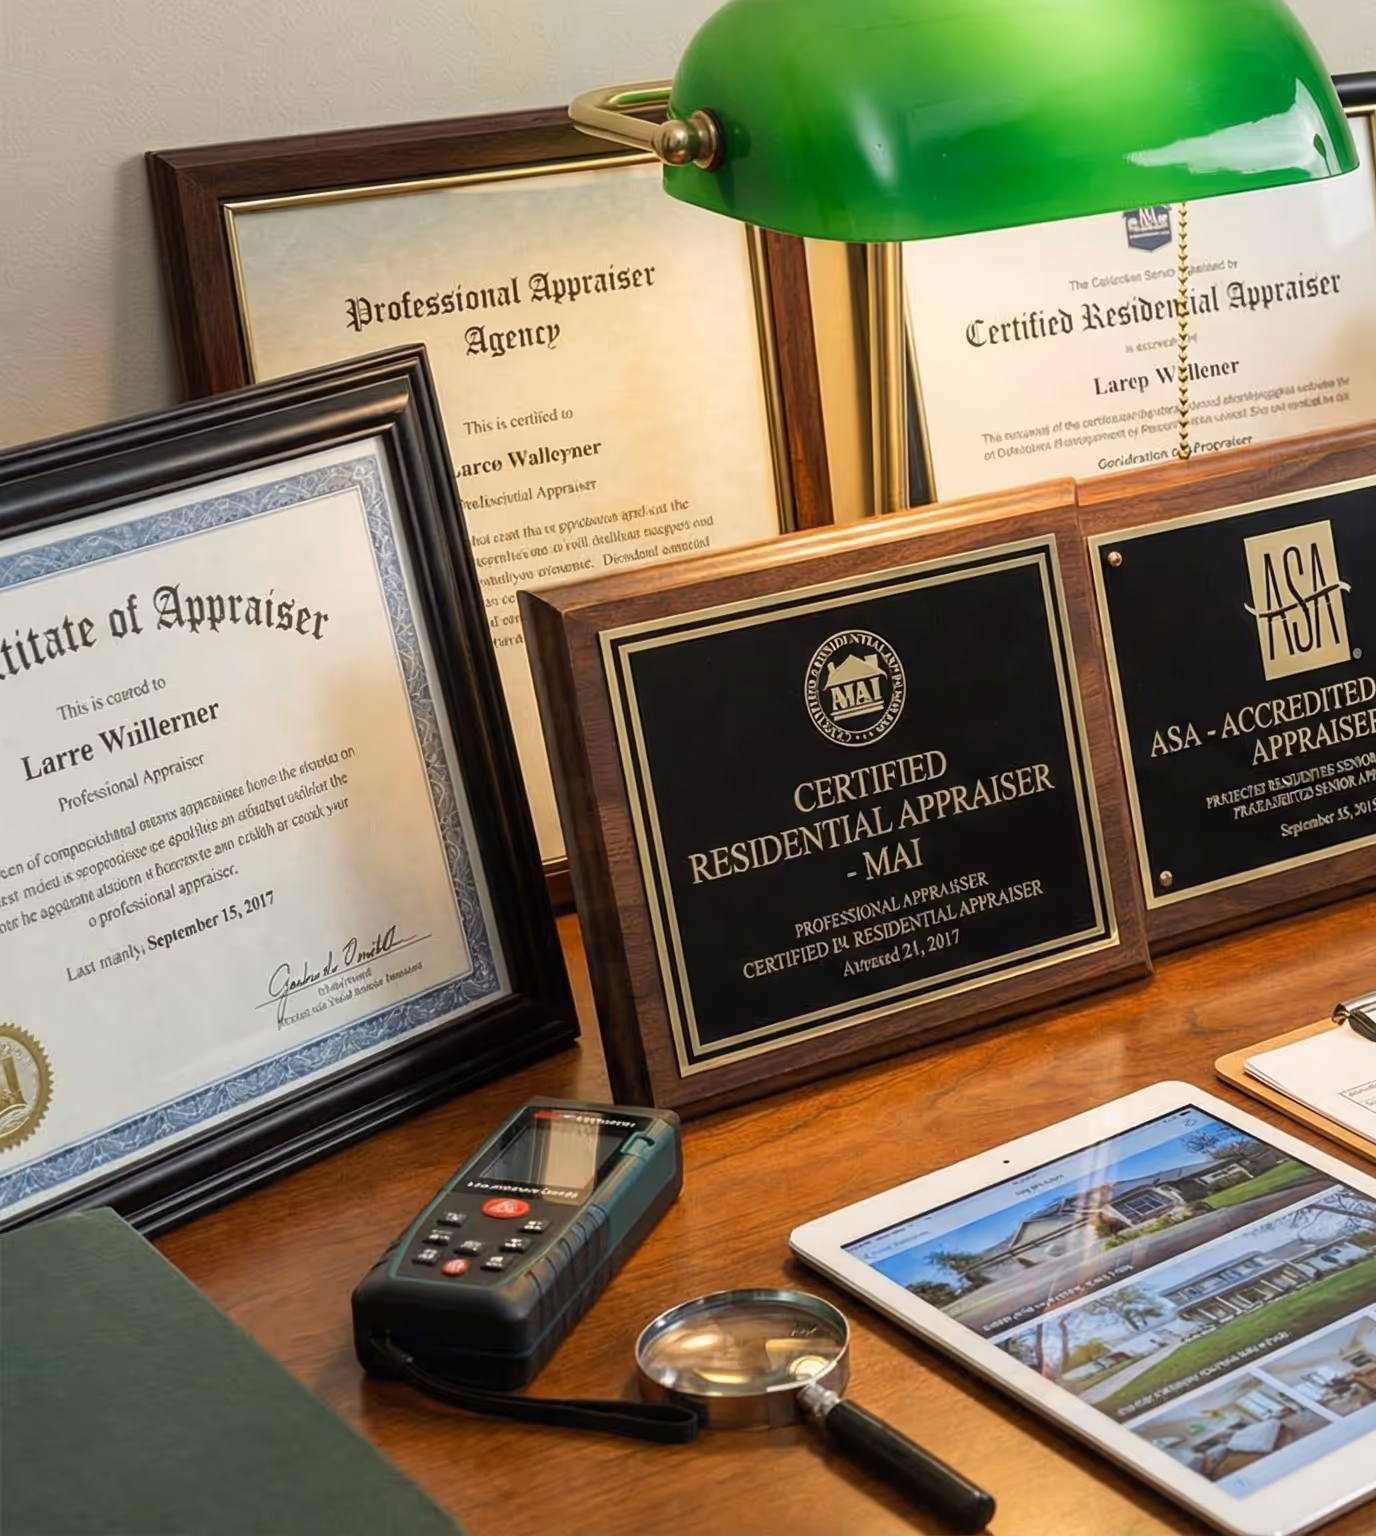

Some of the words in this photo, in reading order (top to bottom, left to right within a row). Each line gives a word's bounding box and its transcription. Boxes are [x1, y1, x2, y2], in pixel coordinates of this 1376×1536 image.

[345, 276, 521, 333] Professional
[528, 263, 657, 304] Appraiser
[965, 307, 1073, 348] Certified
[1226, 272, 1343, 311] Appraiser
[464, 321, 561, 357] Agency
[463, 418, 494, 436] This
[496, 416, 508, 430] is
[561, 408, 574, 419] to
[109, 593, 144, 638] of
[153, 583, 330, 640] Appraiser
[1261, 542, 1341, 661] ASA
[56, 699, 90, 721] This
[91, 696, 104, 712] is
[151, 677, 166, 692] to
[1150, 722, 1203, 758] ASA
[1221, 675, 1376, 739] ACCREDITED
[21, 742, 95, 782] Larre
[58, 772, 140, 813] Professional
[143, 752, 205, 785] Appraiser
[329, 773, 349, 789] the
[793, 749, 948, 813] CERTIFIED
[1314, 774, 1357, 798] SENIOR
[688, 806, 893, 884] RESIDENTIAL
[898, 762, 1056, 830] APPRAISER
[862, 838, 924, 881] MAI
[98, 883, 177, 930] professional
[178, 864, 240, 896] appraiser.
[794, 895, 901, 938] PROFESSIONAL
[66, 960, 97, 982] Last
[147, 914, 220, 951] September
[221, 905, 243, 923] 15,
[243, 890, 275, 916] 2017
[742, 940, 830, 980] CERTIFIED
[853, 904, 959, 948] RESIDENTIAL
[959, 879, 1045, 918] APPRAISER
[902, 940, 925, 960] 21,
[927, 928, 961, 953] 2017
